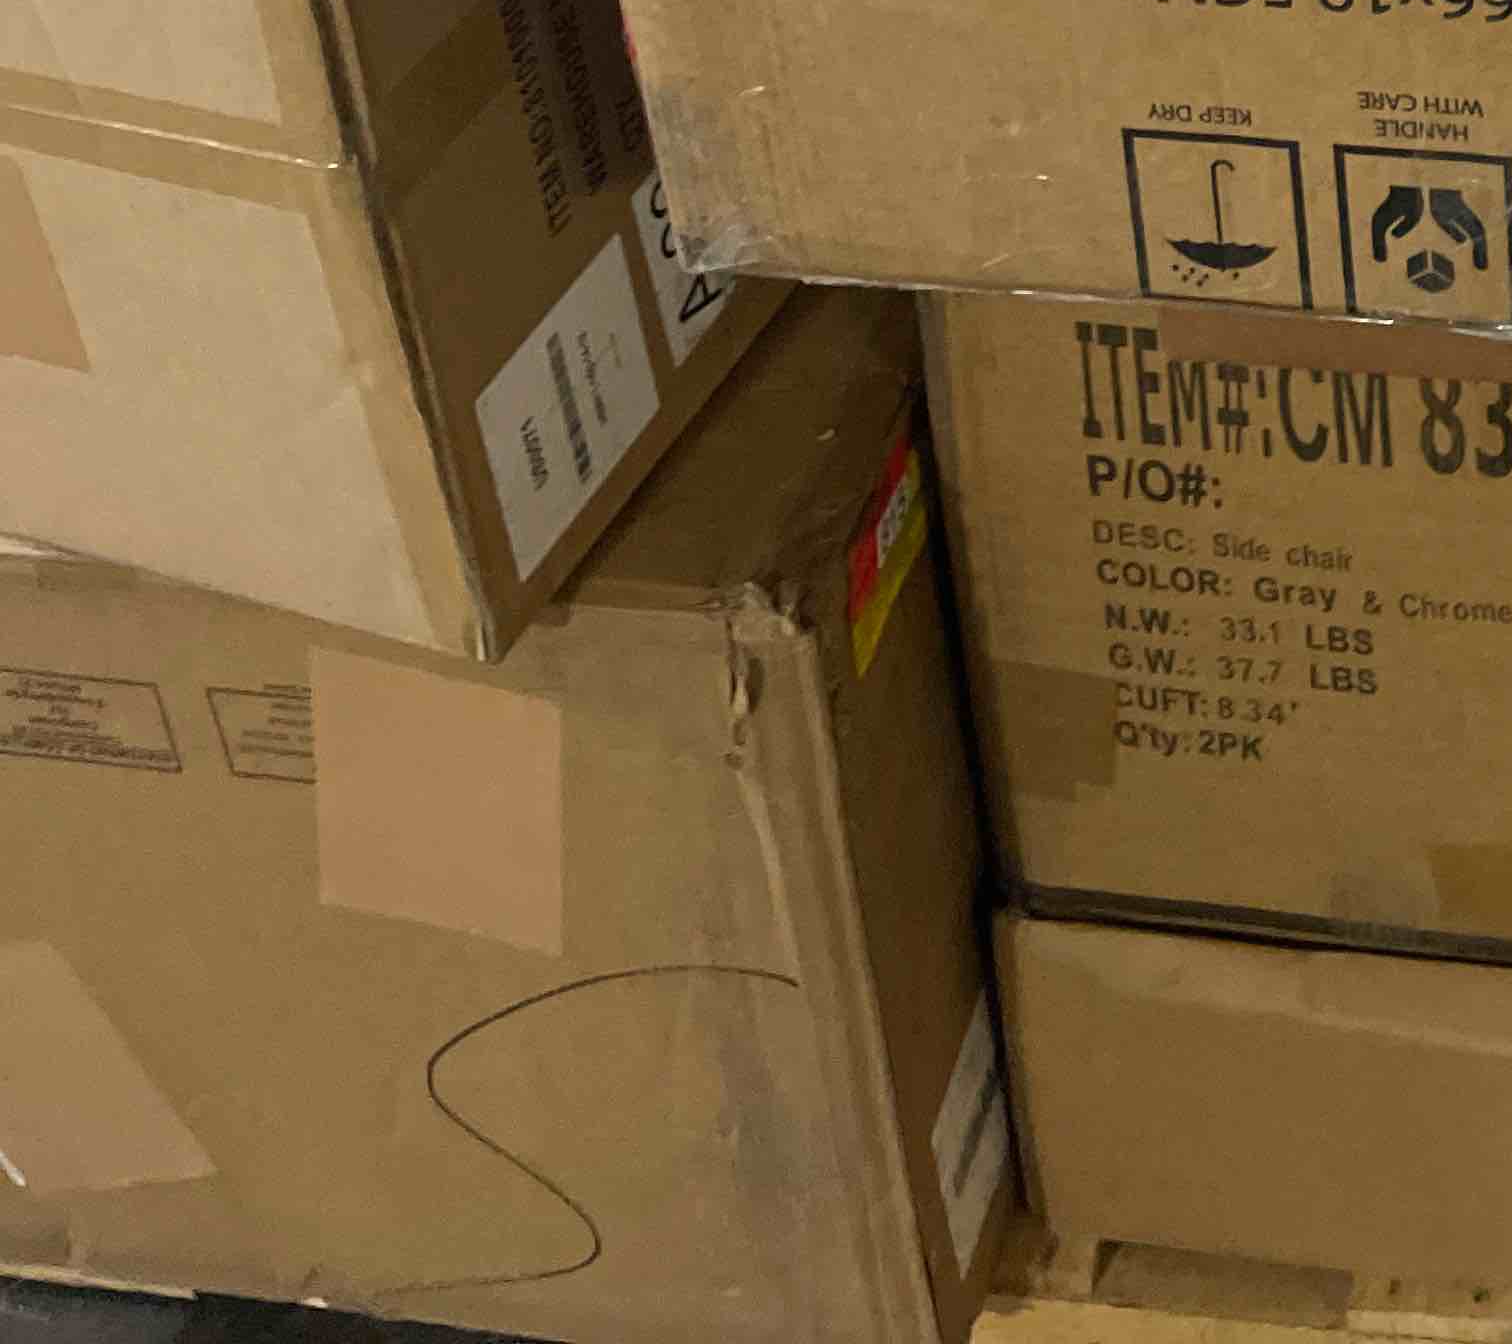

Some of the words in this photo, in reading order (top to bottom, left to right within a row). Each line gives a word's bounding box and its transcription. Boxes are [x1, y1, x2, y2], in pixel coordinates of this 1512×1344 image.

[1148, 103, 1192, 124] DRY
[1199, 106, 1253, 128] KEEP
[1358, 90, 1417, 114] CARE
[1422, 95, 1484, 119] WITH
[1374, 118, 1469, 143] HANDLE
[1086, 453, 1223, 509] P/O#:
[1092, 519, 1197, 557] DESC:
[1212, 532, 1272, 563] Side
[1285, 543, 1355, 572] chair
[1096, 558, 1233, 598] COLOR:
[1253, 576, 1338, 614] Gray
[1362, 590, 1384, 616] &
[1104, 604, 1190, 638] N.W.:
[1219, 616, 1282, 647] 33.1
[1304, 622, 1376, 656] LBS
[1108, 642, 1198, 678] G.W.:
[1216, 654, 1284, 687] 37.7
[1309, 663, 1379, 698] LBS
[1114, 680, 1209, 718] CUFT:
[1199, 728, 1264, 762] 2PK
